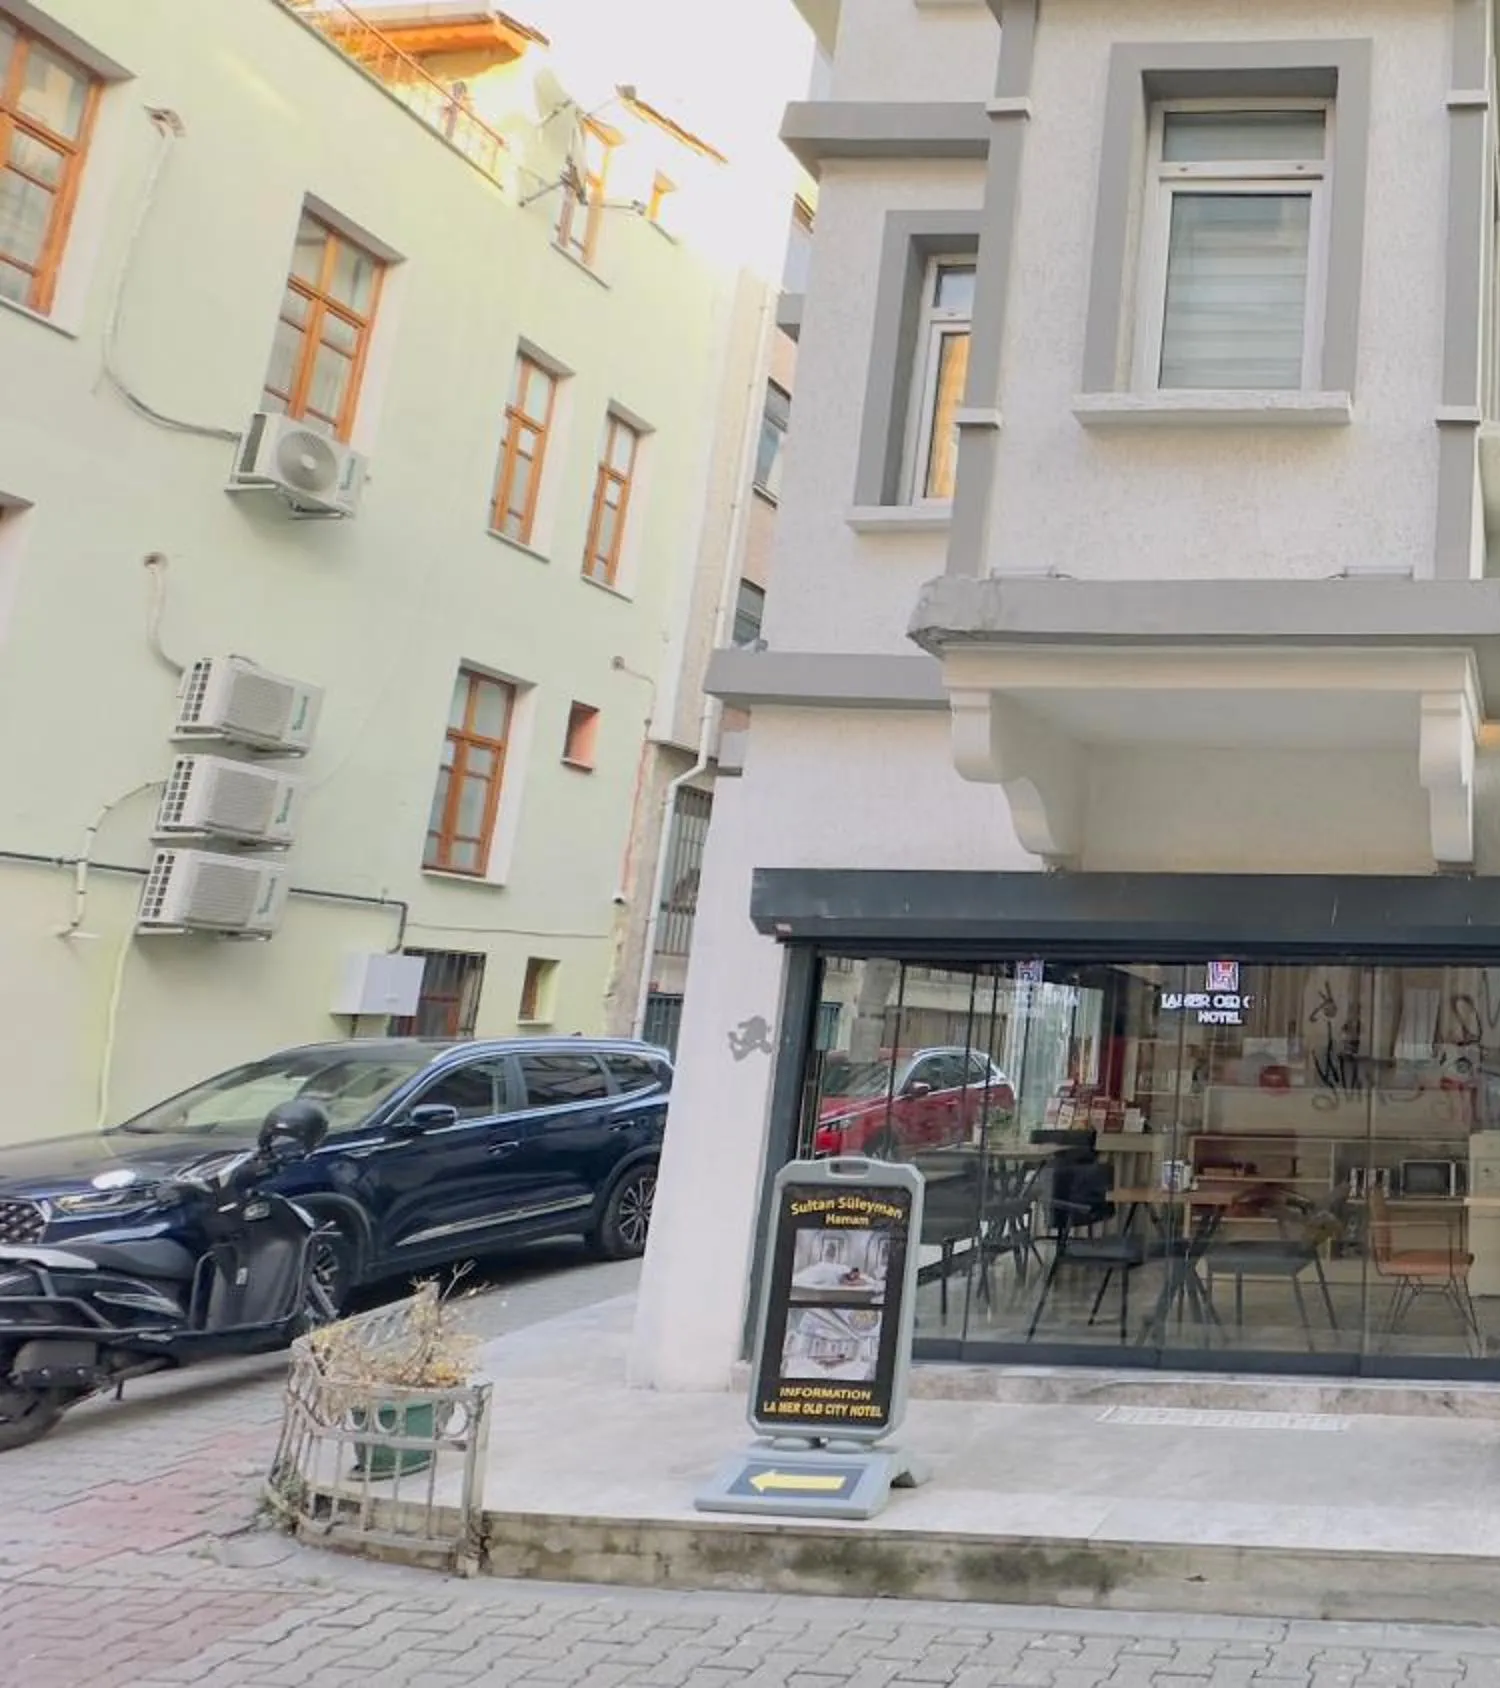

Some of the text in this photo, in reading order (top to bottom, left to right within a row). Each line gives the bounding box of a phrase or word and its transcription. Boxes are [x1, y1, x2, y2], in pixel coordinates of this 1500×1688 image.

[790, 1196, 903, 1219] Sultan Süleyman
[825, 1213, 870, 1225] Hamam
[779, 1386, 872, 1400] INFORMATION
[763, 1400, 776, 1412] LA
[802, 1402, 823, 1415] OLD
[825, 1403, 849, 1416] CITY
[849, 1405, 883, 1418] HOTEL
